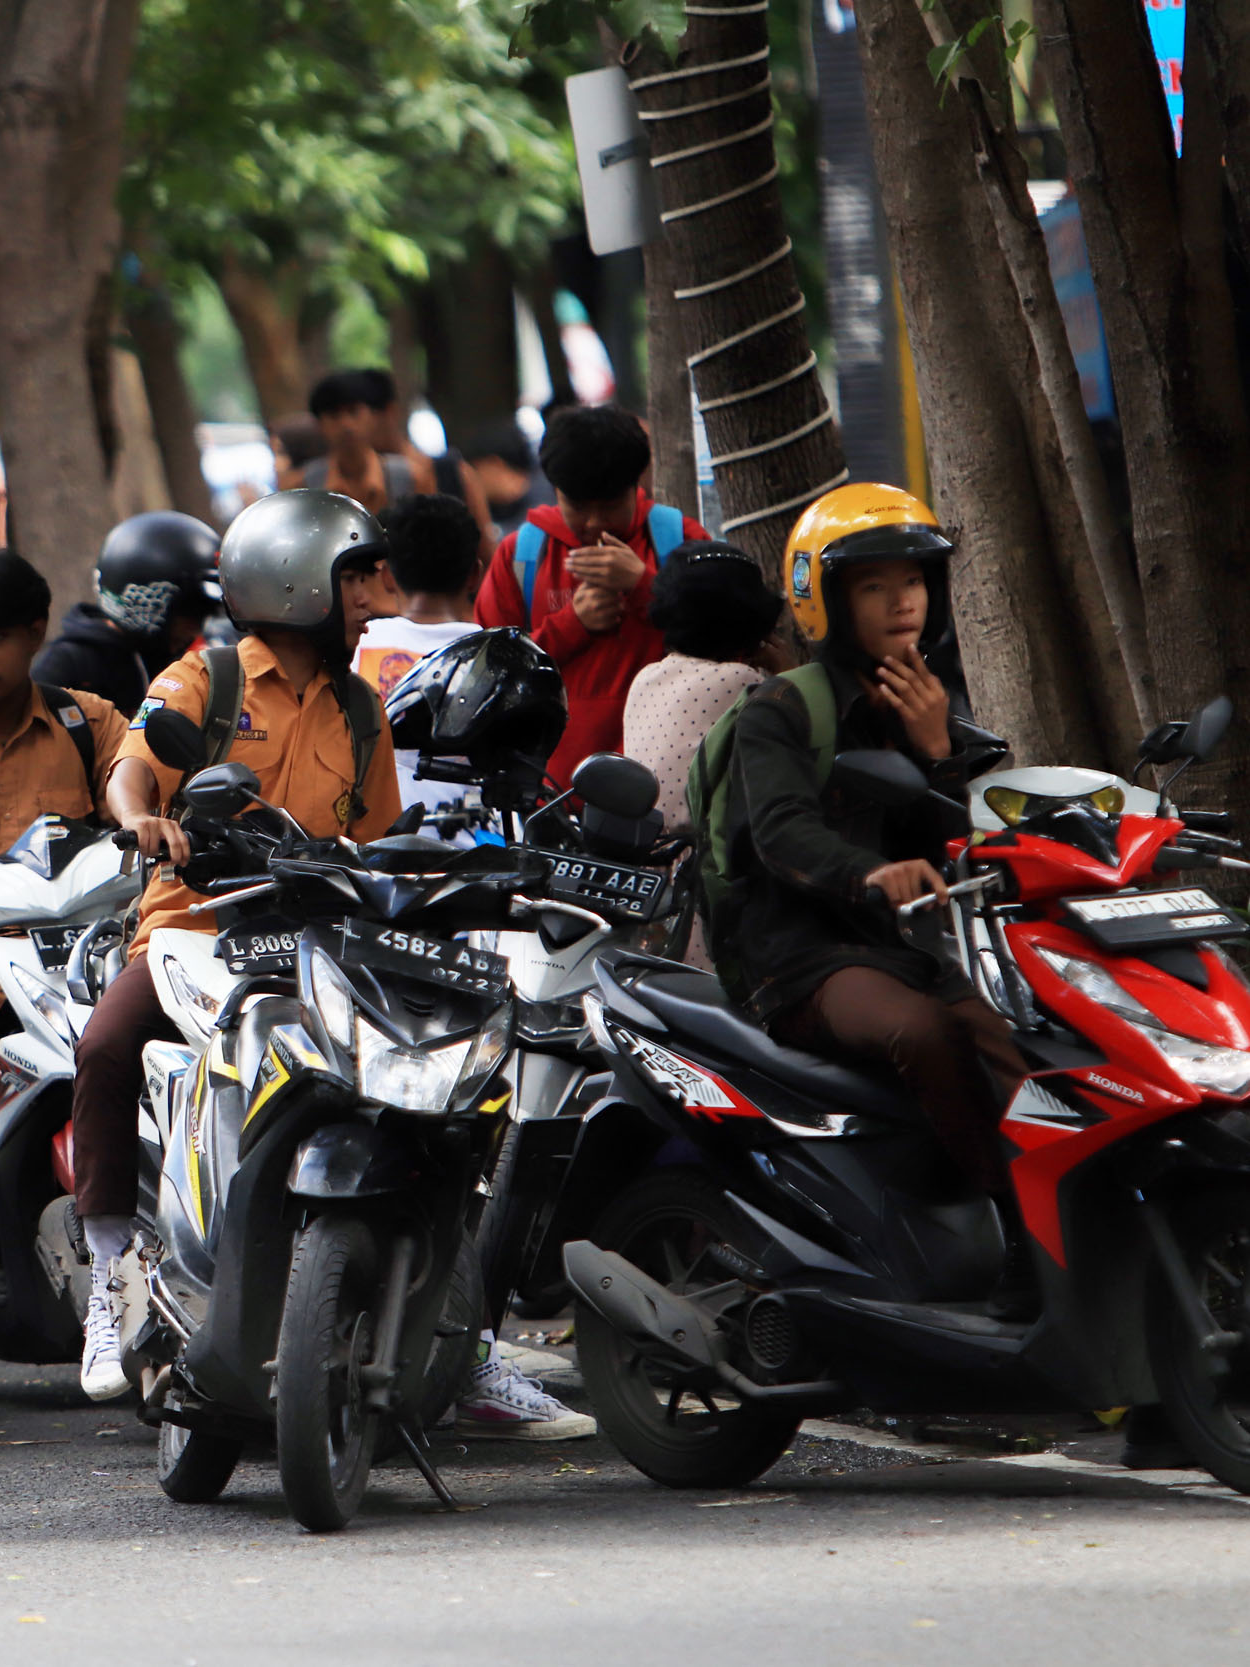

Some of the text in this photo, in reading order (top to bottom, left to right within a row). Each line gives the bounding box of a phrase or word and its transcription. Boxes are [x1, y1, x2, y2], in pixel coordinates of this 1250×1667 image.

[605, 871, 655, 895] AAE
[34, 931, 54, 951] L
[228, 938, 246, 957] L
[531, 960, 566, 971] HONDA
[3, 1047, 39, 1075] HONDA
[270, 1033, 294, 1071] HONDA
[1088, 1071, 1146, 1103] HONDA
